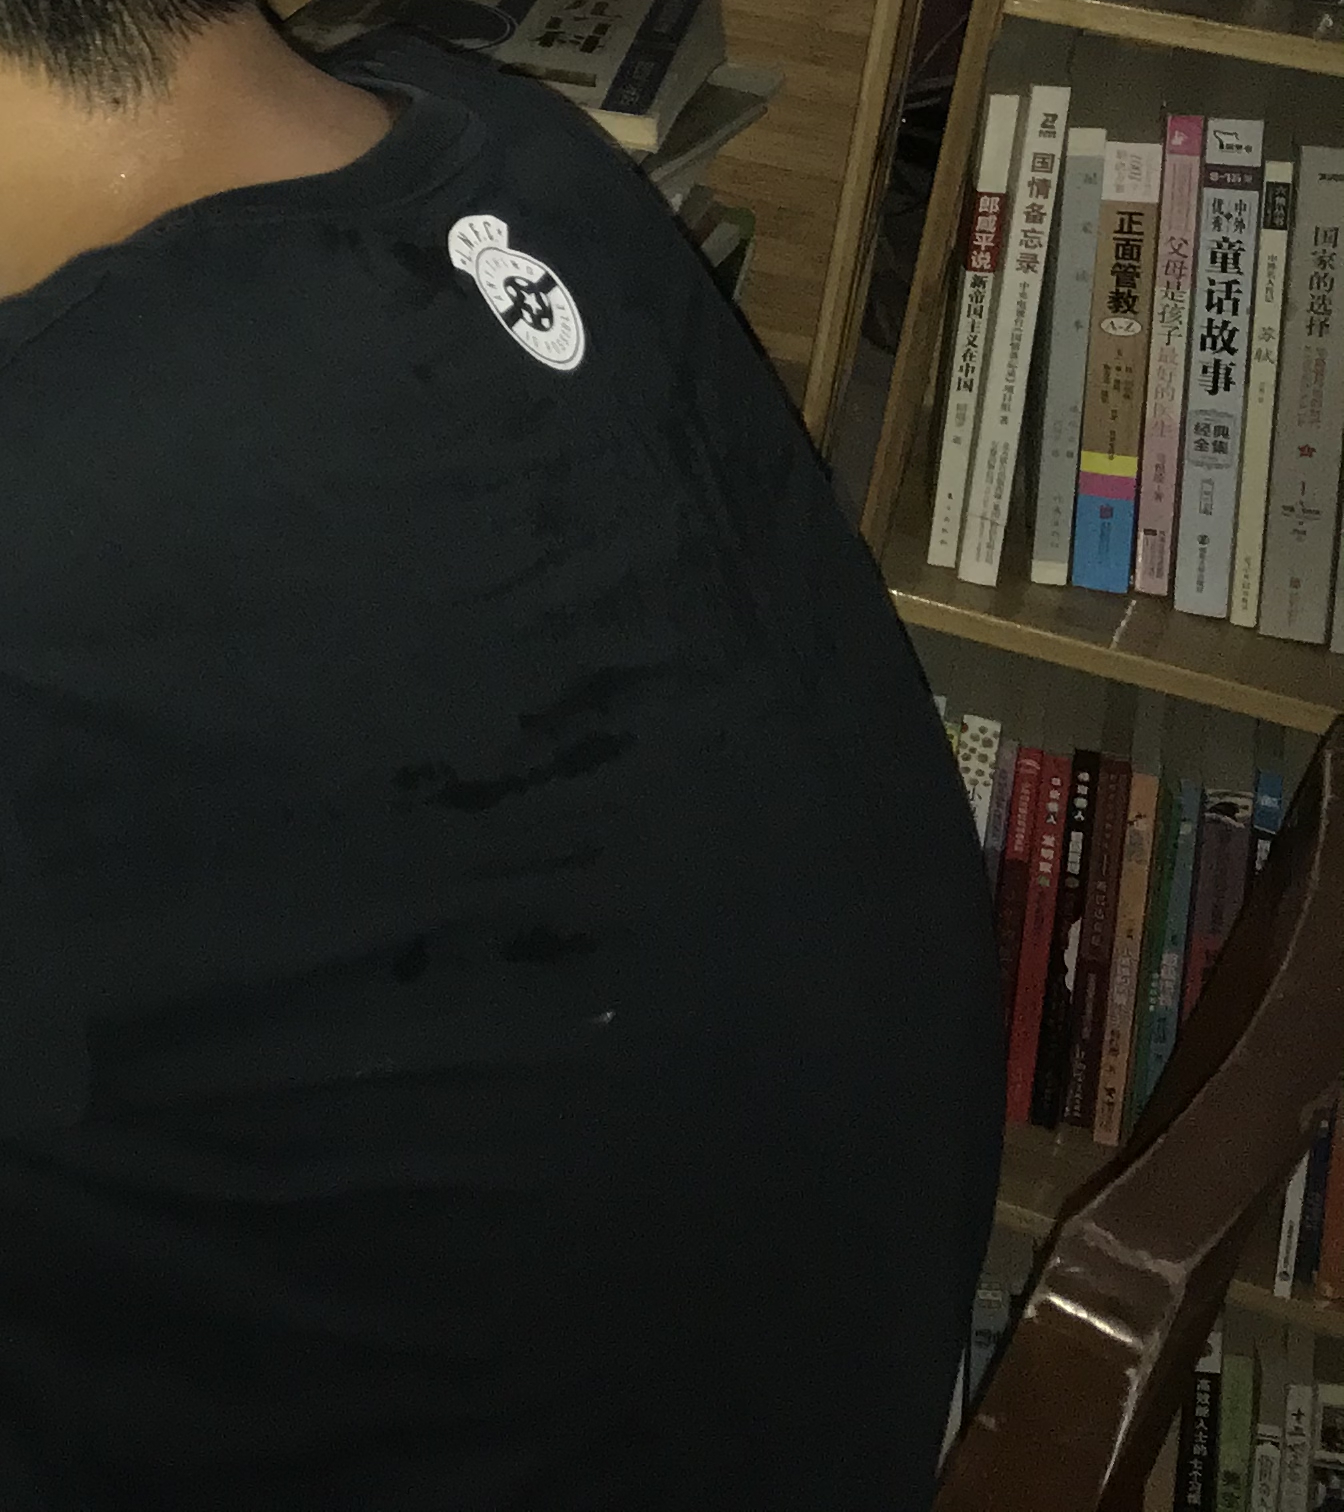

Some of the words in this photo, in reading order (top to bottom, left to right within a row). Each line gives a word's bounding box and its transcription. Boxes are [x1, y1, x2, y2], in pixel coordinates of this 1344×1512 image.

[969, 194, 1001, 271] 郎咸平说
[1015, 151, 1058, 275] 国情备忘录
[1107, 209, 1146, 317] 正面管教
[955, 274, 994, 393] 新帝国主义在中国
[1151, 235, 1190, 440] 父母是孩子最好的医生
[1198, 236, 1246, 397] 童话故事
[1306, 224, 1340, 339] 国家的选择
